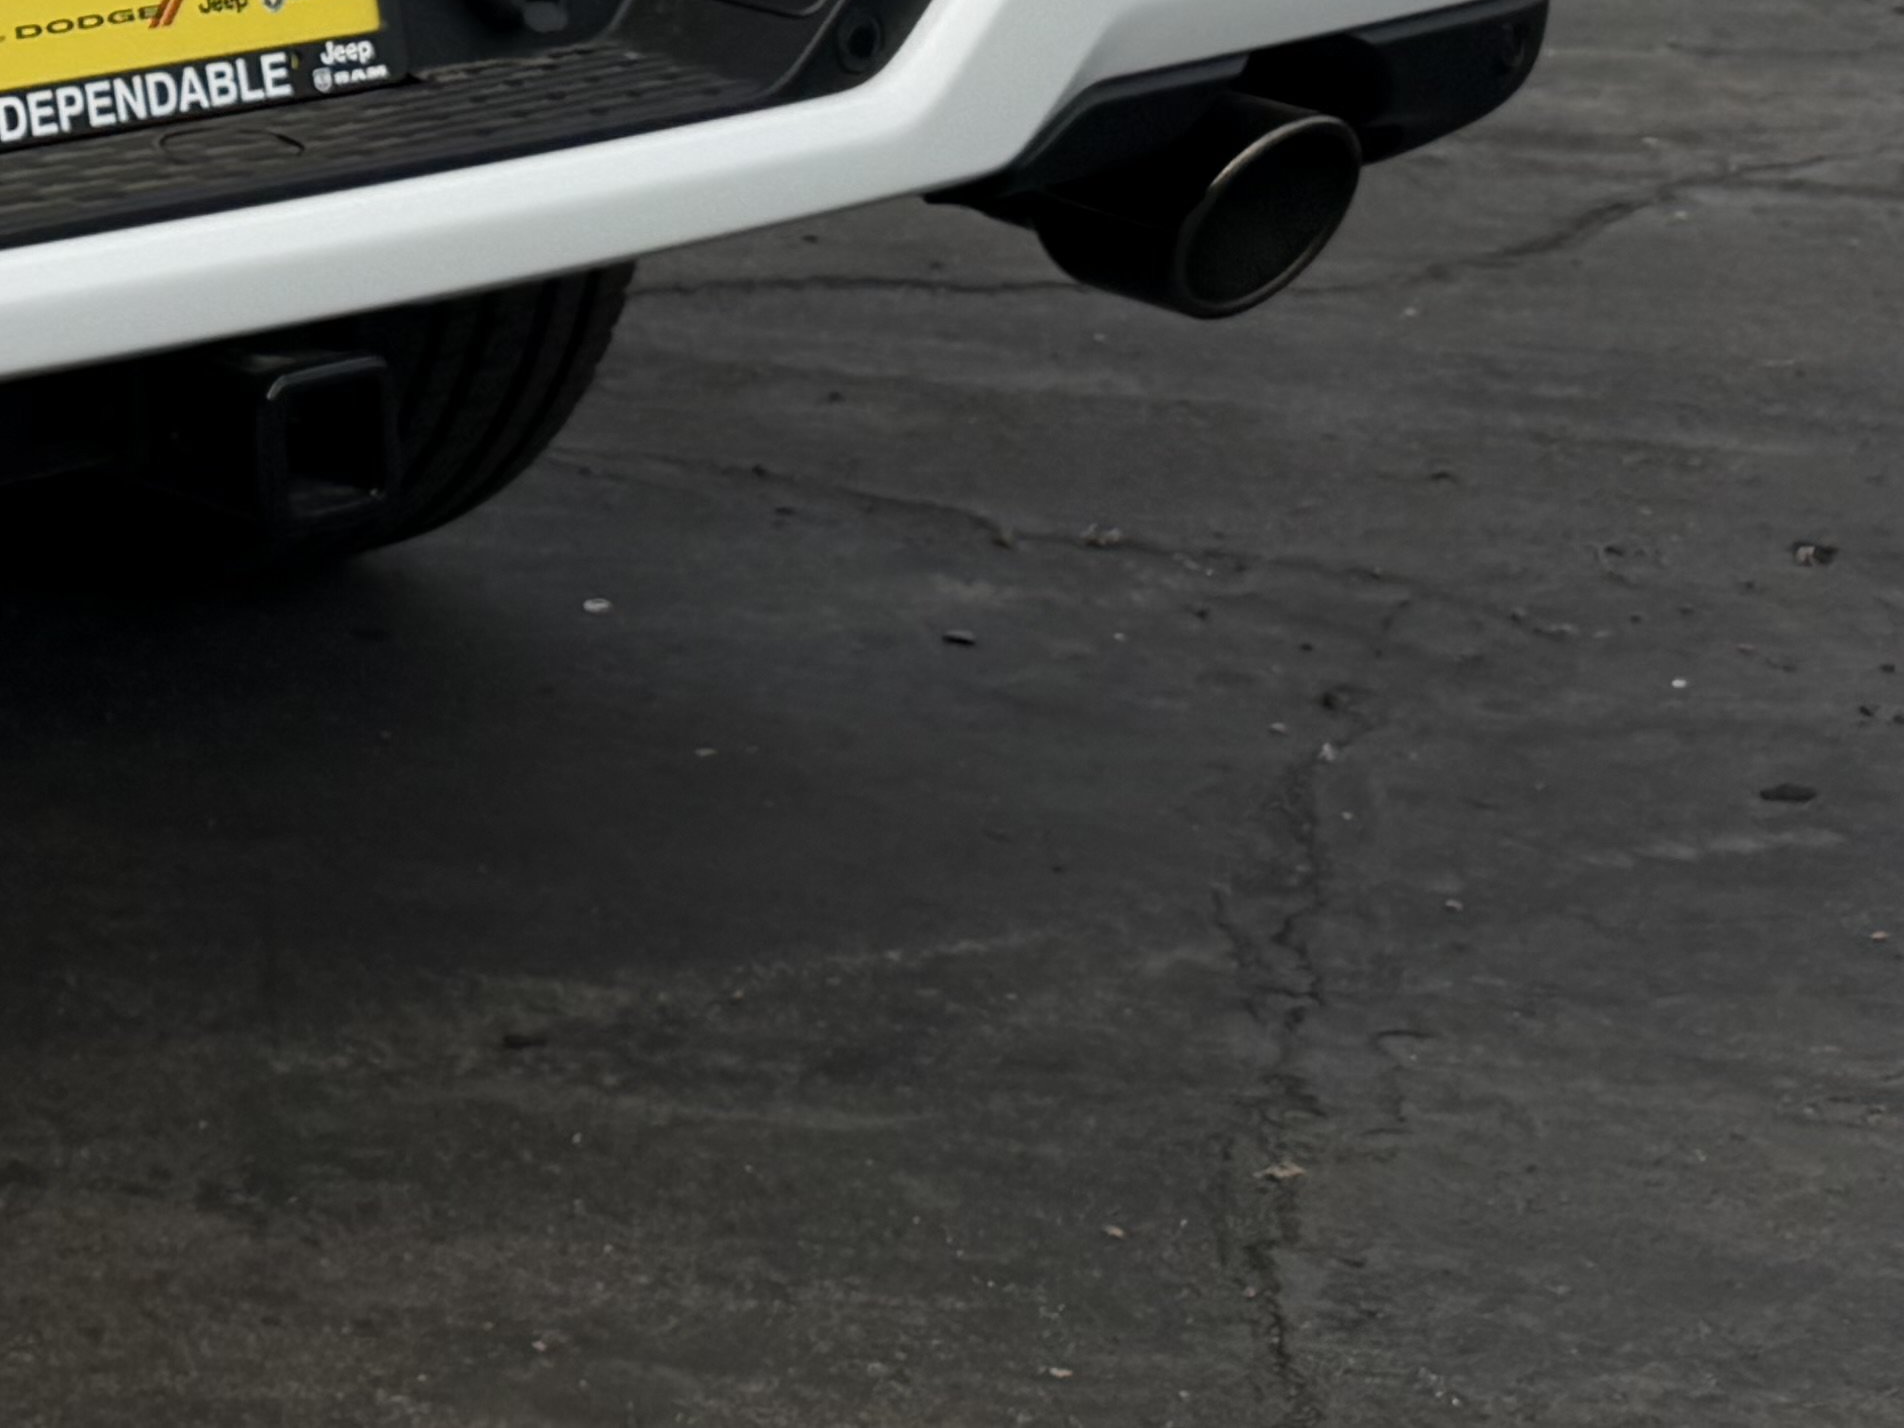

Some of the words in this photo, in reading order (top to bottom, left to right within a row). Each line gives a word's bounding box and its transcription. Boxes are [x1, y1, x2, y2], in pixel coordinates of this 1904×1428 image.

[15, 3, 162, 41] DODGE
[320, 39, 377, 65] Jeep
[333, 63, 391, 86] RAM
